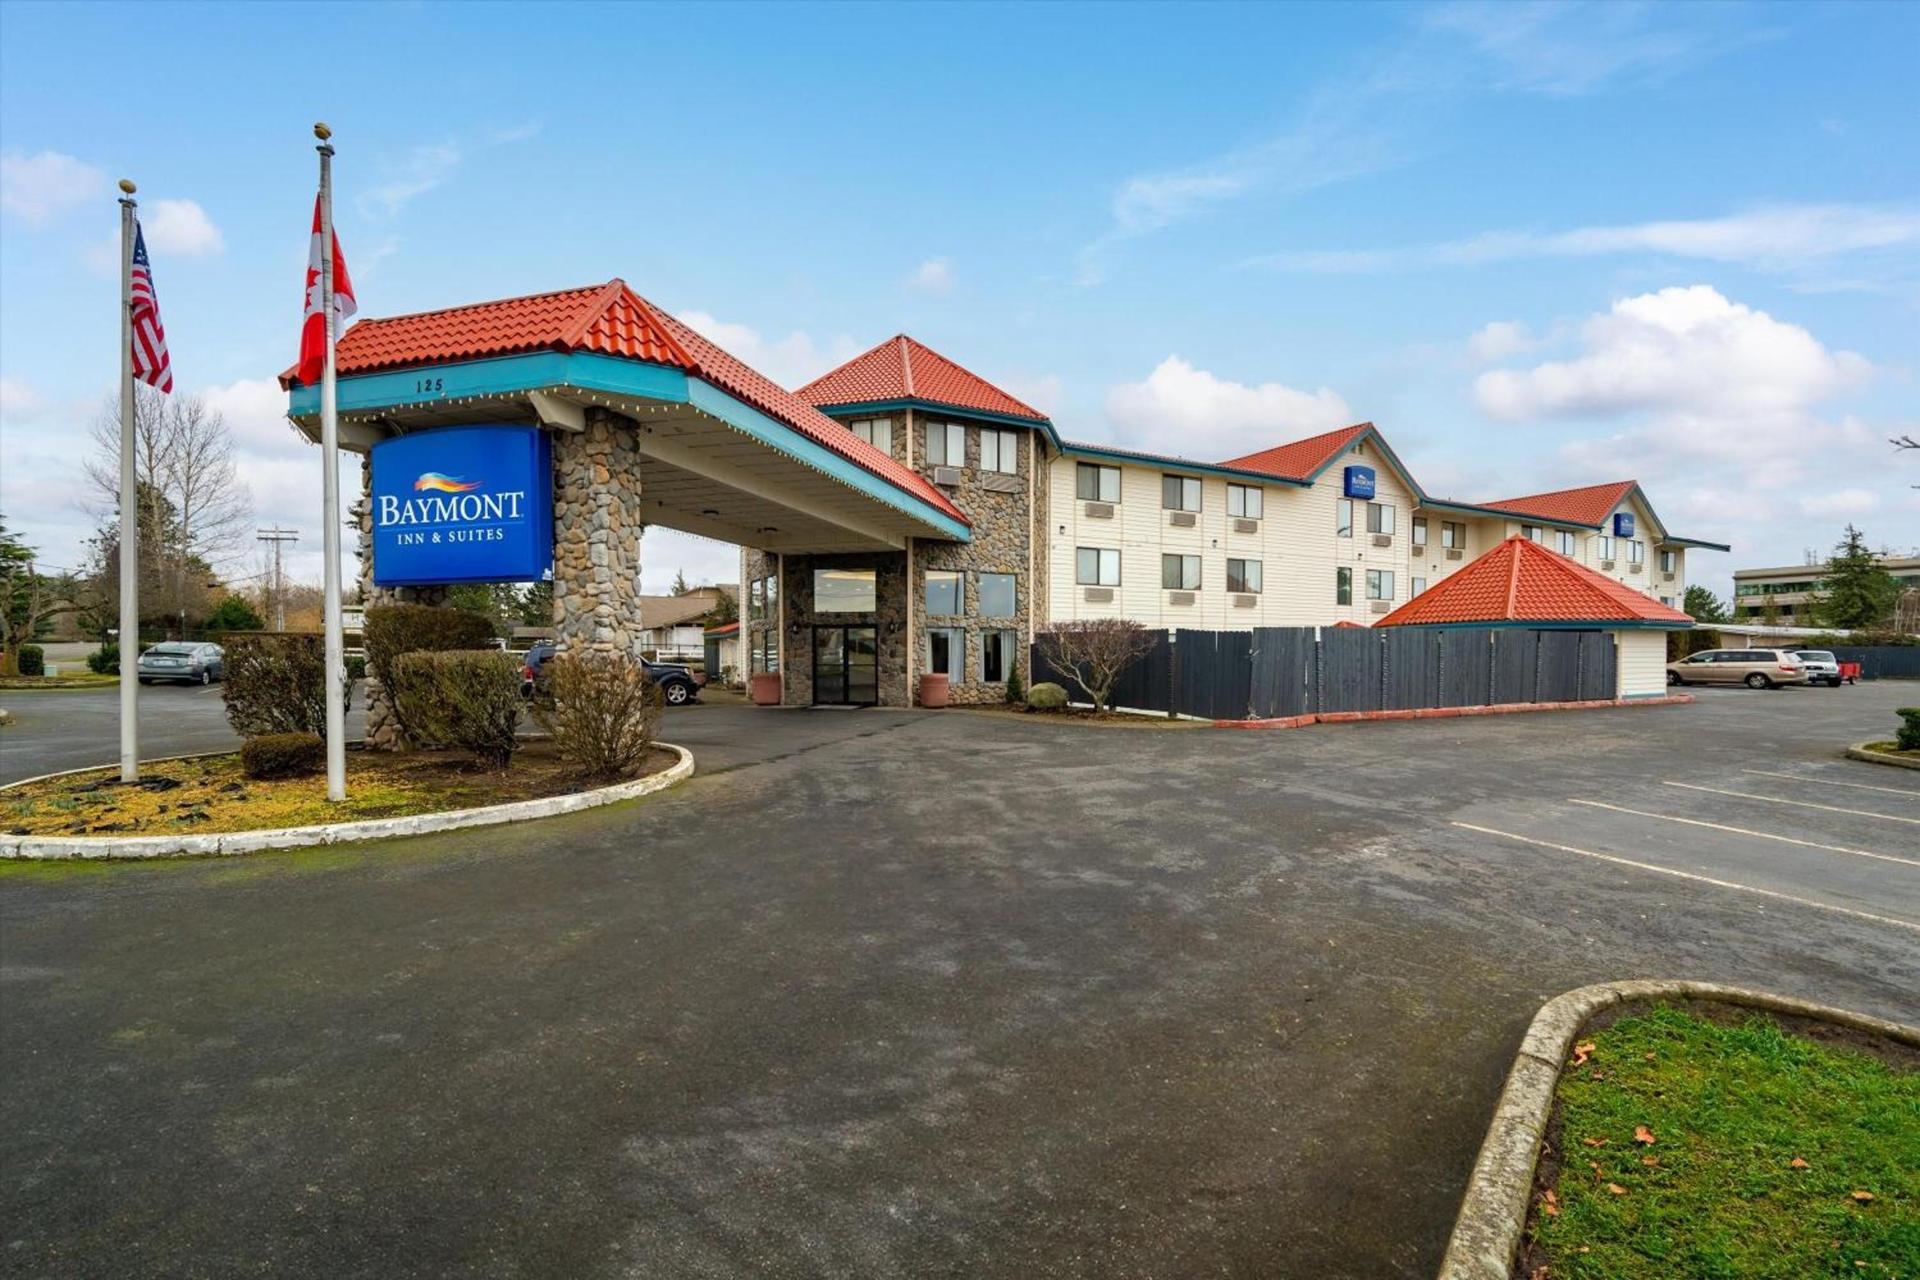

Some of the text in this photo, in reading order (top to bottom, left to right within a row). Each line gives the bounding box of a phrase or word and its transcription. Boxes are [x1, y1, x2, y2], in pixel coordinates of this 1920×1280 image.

[416, 378, 443, 393] 125
[378, 491, 524, 526] BAYMONT
[397, 528, 504, 545] INN & SUITES
